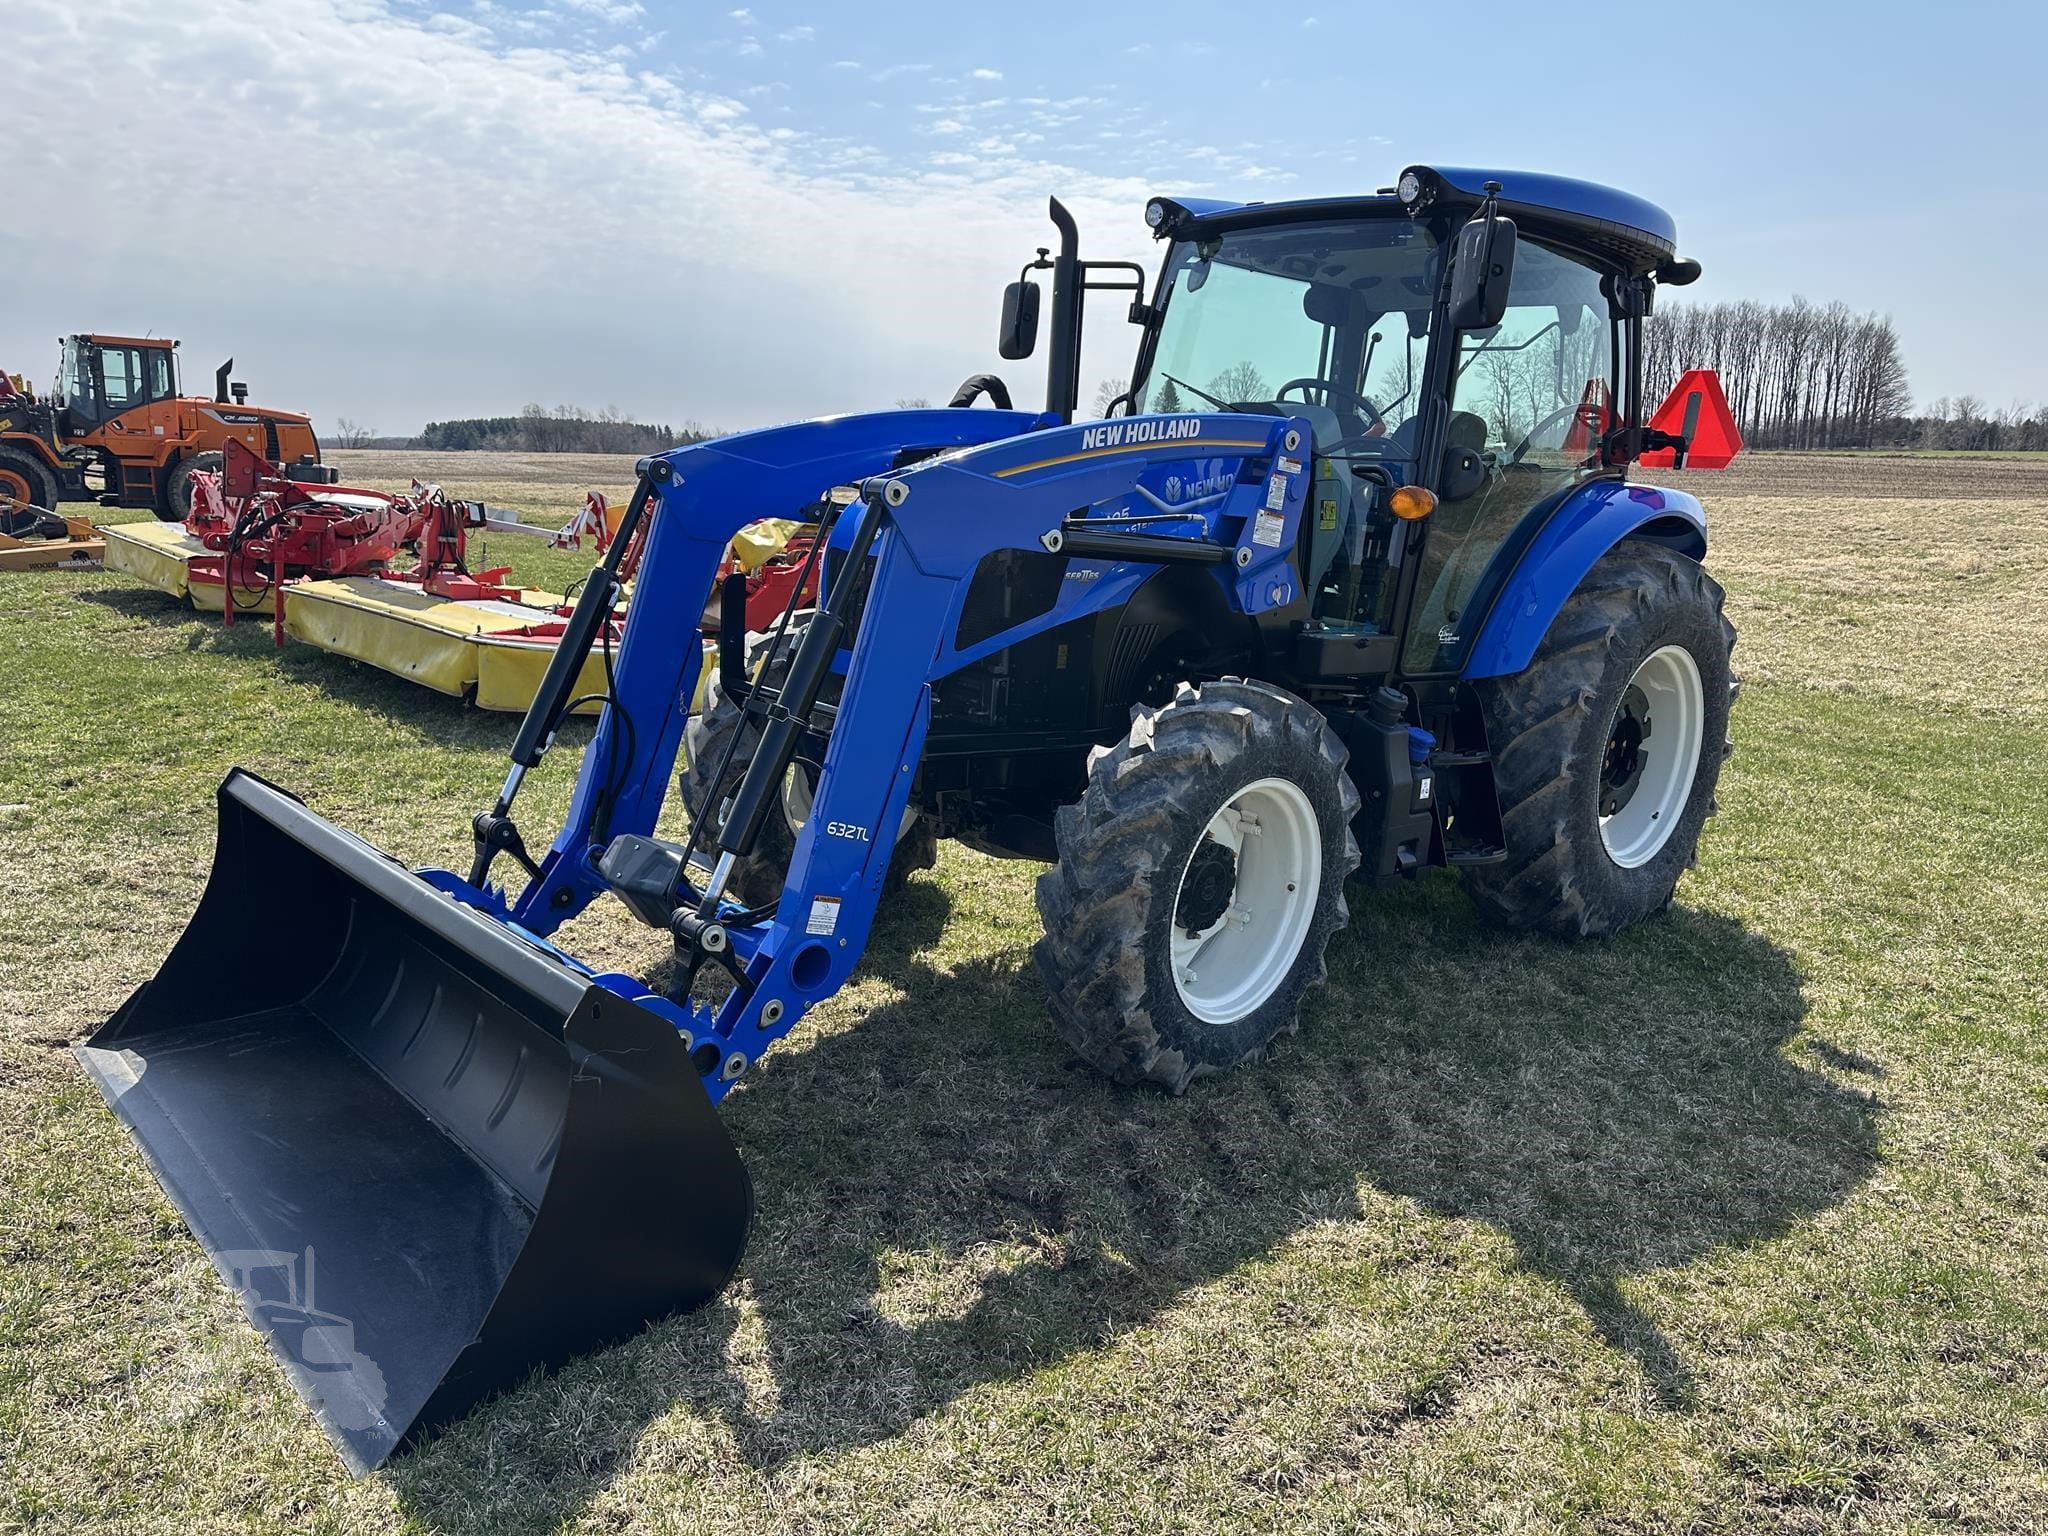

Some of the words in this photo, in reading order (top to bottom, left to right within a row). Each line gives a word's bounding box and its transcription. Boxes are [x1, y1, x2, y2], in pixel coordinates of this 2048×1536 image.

[1082, 425, 1123, 450] NEW
[1125, 419, 1201, 443] HOLLAND
[1185, 478, 1214, 499] NEW
[827, 821, 869, 841] 632TL
